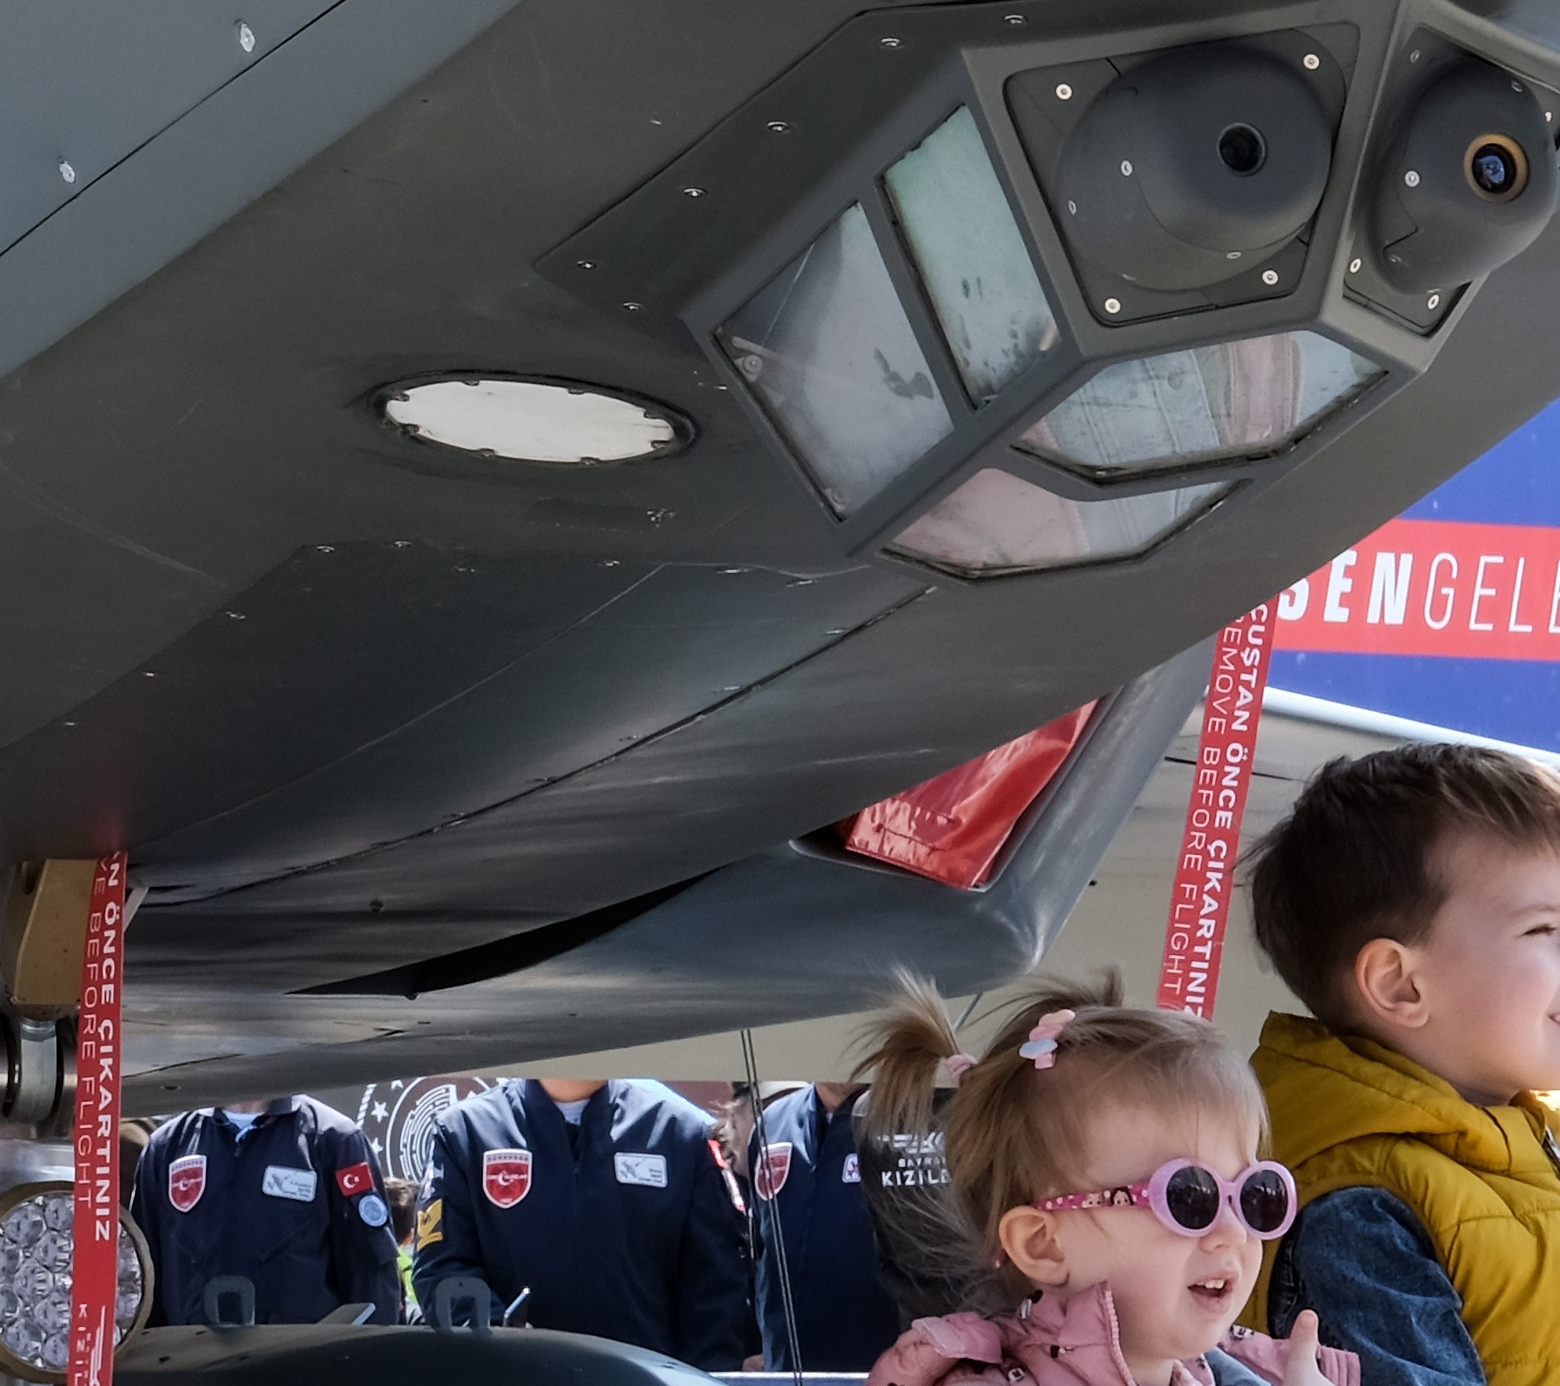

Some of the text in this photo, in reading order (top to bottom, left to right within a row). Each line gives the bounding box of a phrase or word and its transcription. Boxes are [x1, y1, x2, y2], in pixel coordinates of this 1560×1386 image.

[1230, 603, 1268, 731] ÇUŞTAN
[1163, 614, 1245, 995] EMOVE BEFORE FLIGHT
[1215, 742, 1249, 830] ÖNCE
[82, 912, 102, 1059] BEFORE
[100, 901, 121, 1005] ÖNCE
[77, 1076, 96, 1210] FLIGHT
[93, 1015, 116, 1242] ÇIKARTINIZ
